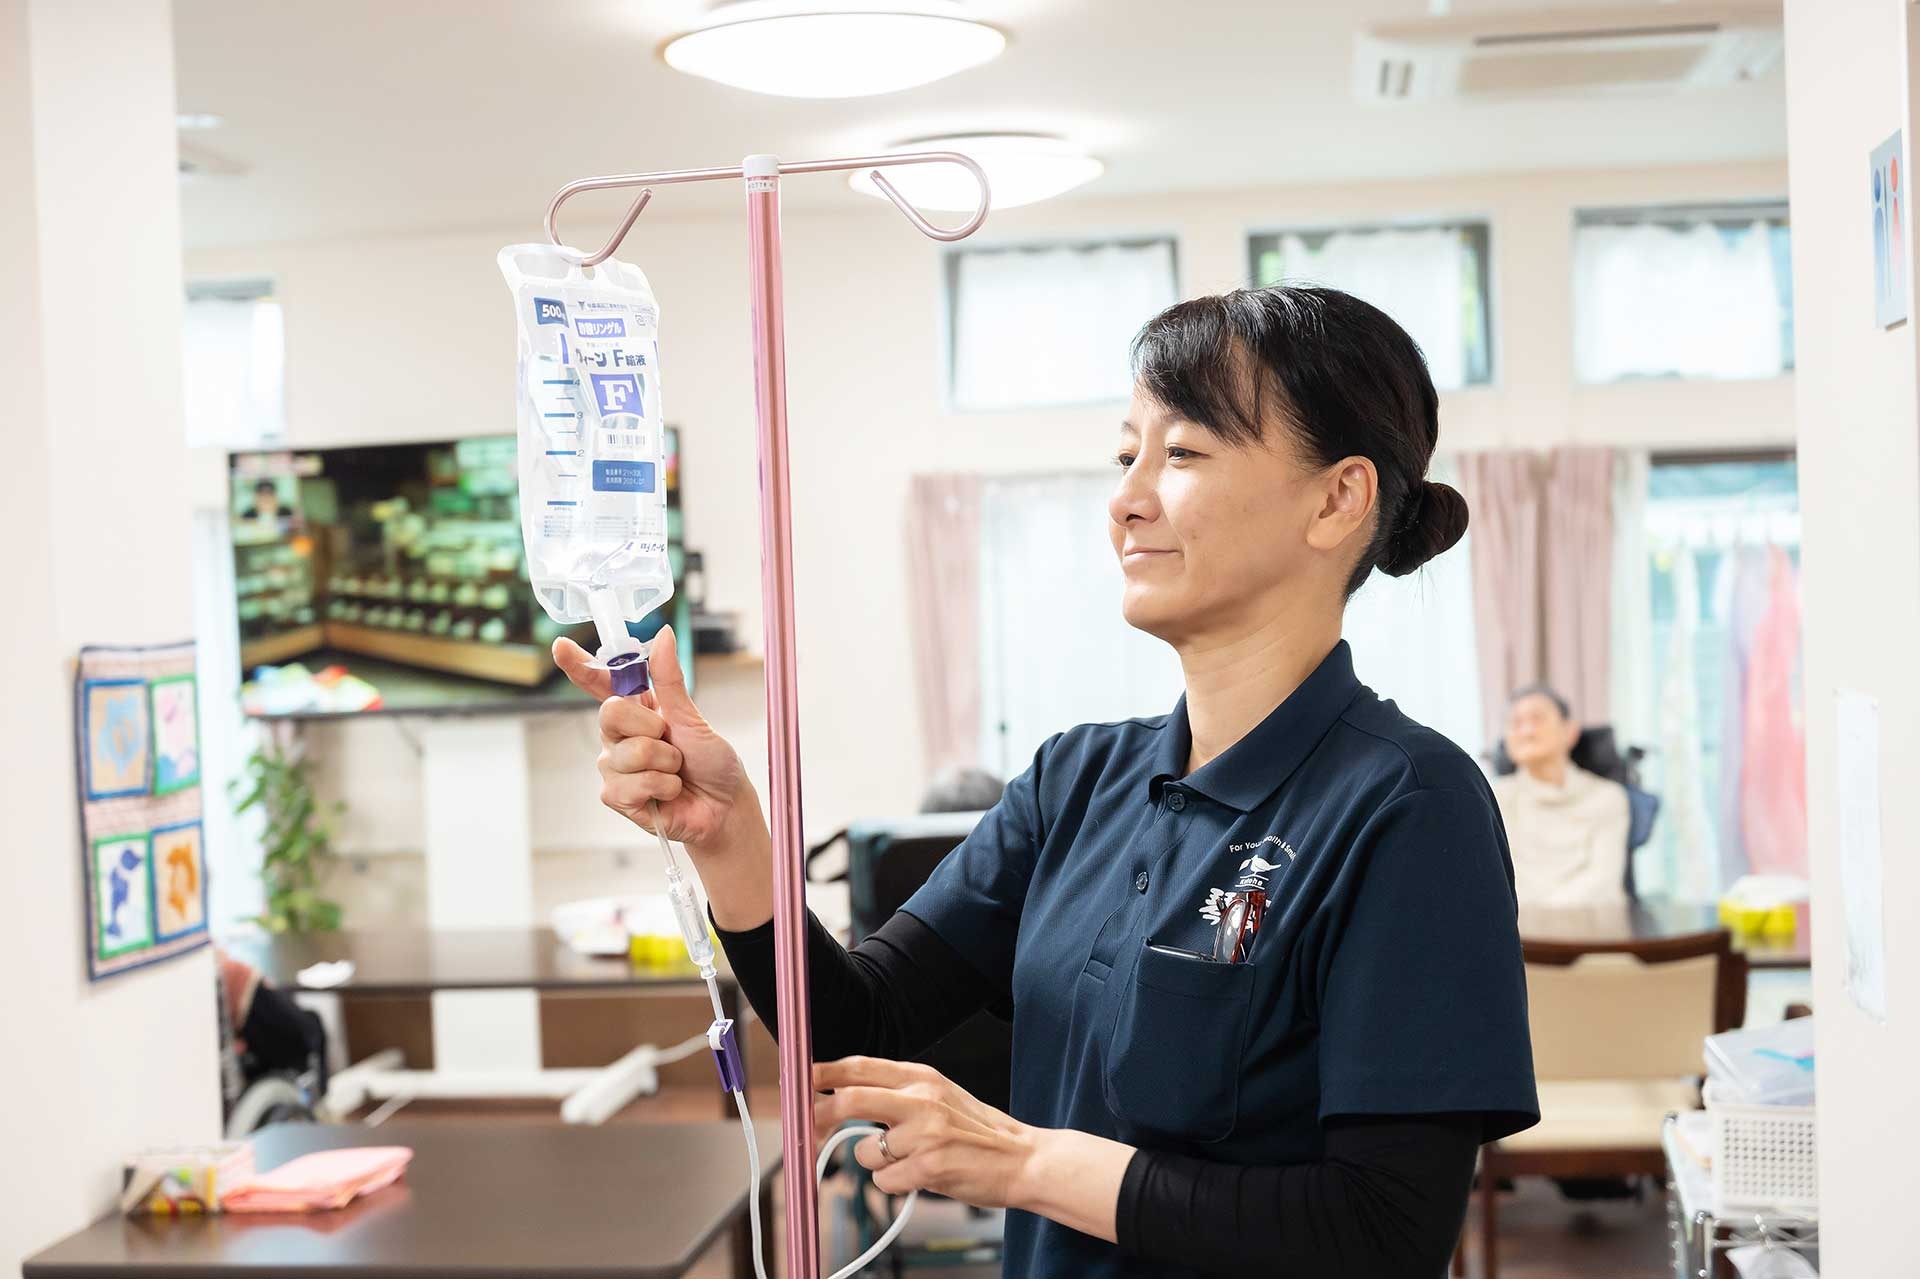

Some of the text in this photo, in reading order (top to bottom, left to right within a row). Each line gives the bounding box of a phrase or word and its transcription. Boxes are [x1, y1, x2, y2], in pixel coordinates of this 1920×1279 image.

[599, 379, 634, 411] F
[577, 449, 584, 457] 2
[1229, 844, 1243, 853] For
